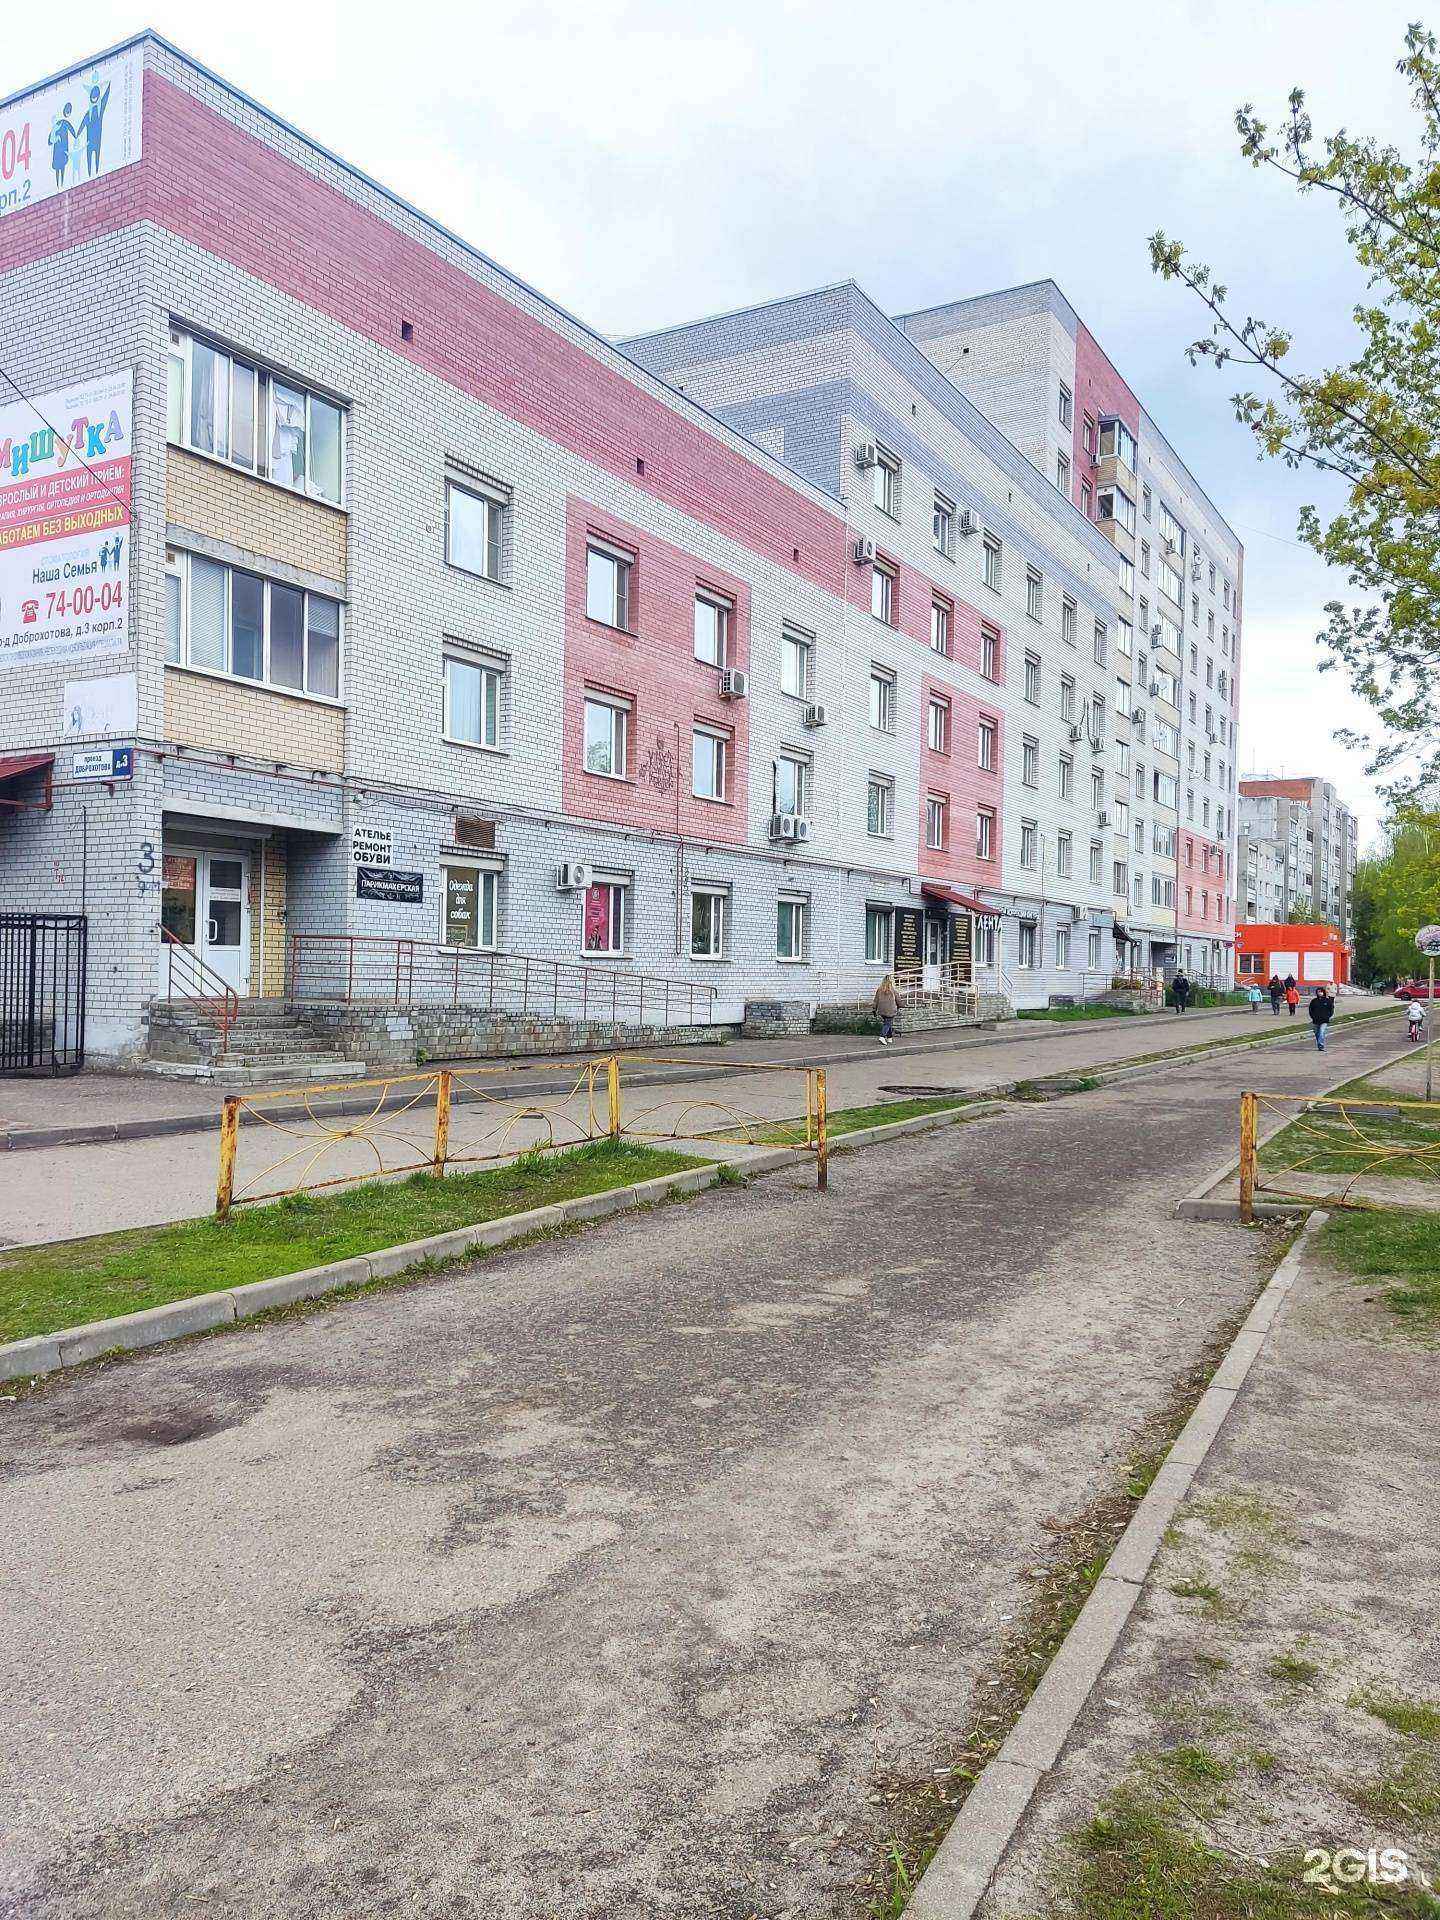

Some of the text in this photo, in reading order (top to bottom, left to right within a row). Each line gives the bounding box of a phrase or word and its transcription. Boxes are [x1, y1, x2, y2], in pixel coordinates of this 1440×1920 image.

[40, 484, 47, 498] И
[48, 471, 89, 498] ДЕТСКИЙ
[43, 520, 62, 537] БЕЗ
[64, 505, 124, 532] ВЫХОДНЫХ
[32, 561, 98, 584] Наша Семья
[45, 580, 123, 619] 74-00-04
[12, 626, 73, 646] Доброхотова,
[354, 828, 392, 841] АТЕЛЬЕ
[352, 841, 392, 854] РЕМОНТ
[353, 852, 391, 865] ОБУВИ
[361, 879, 420, 893] ПАРИКМАХЕРСКАЯ
